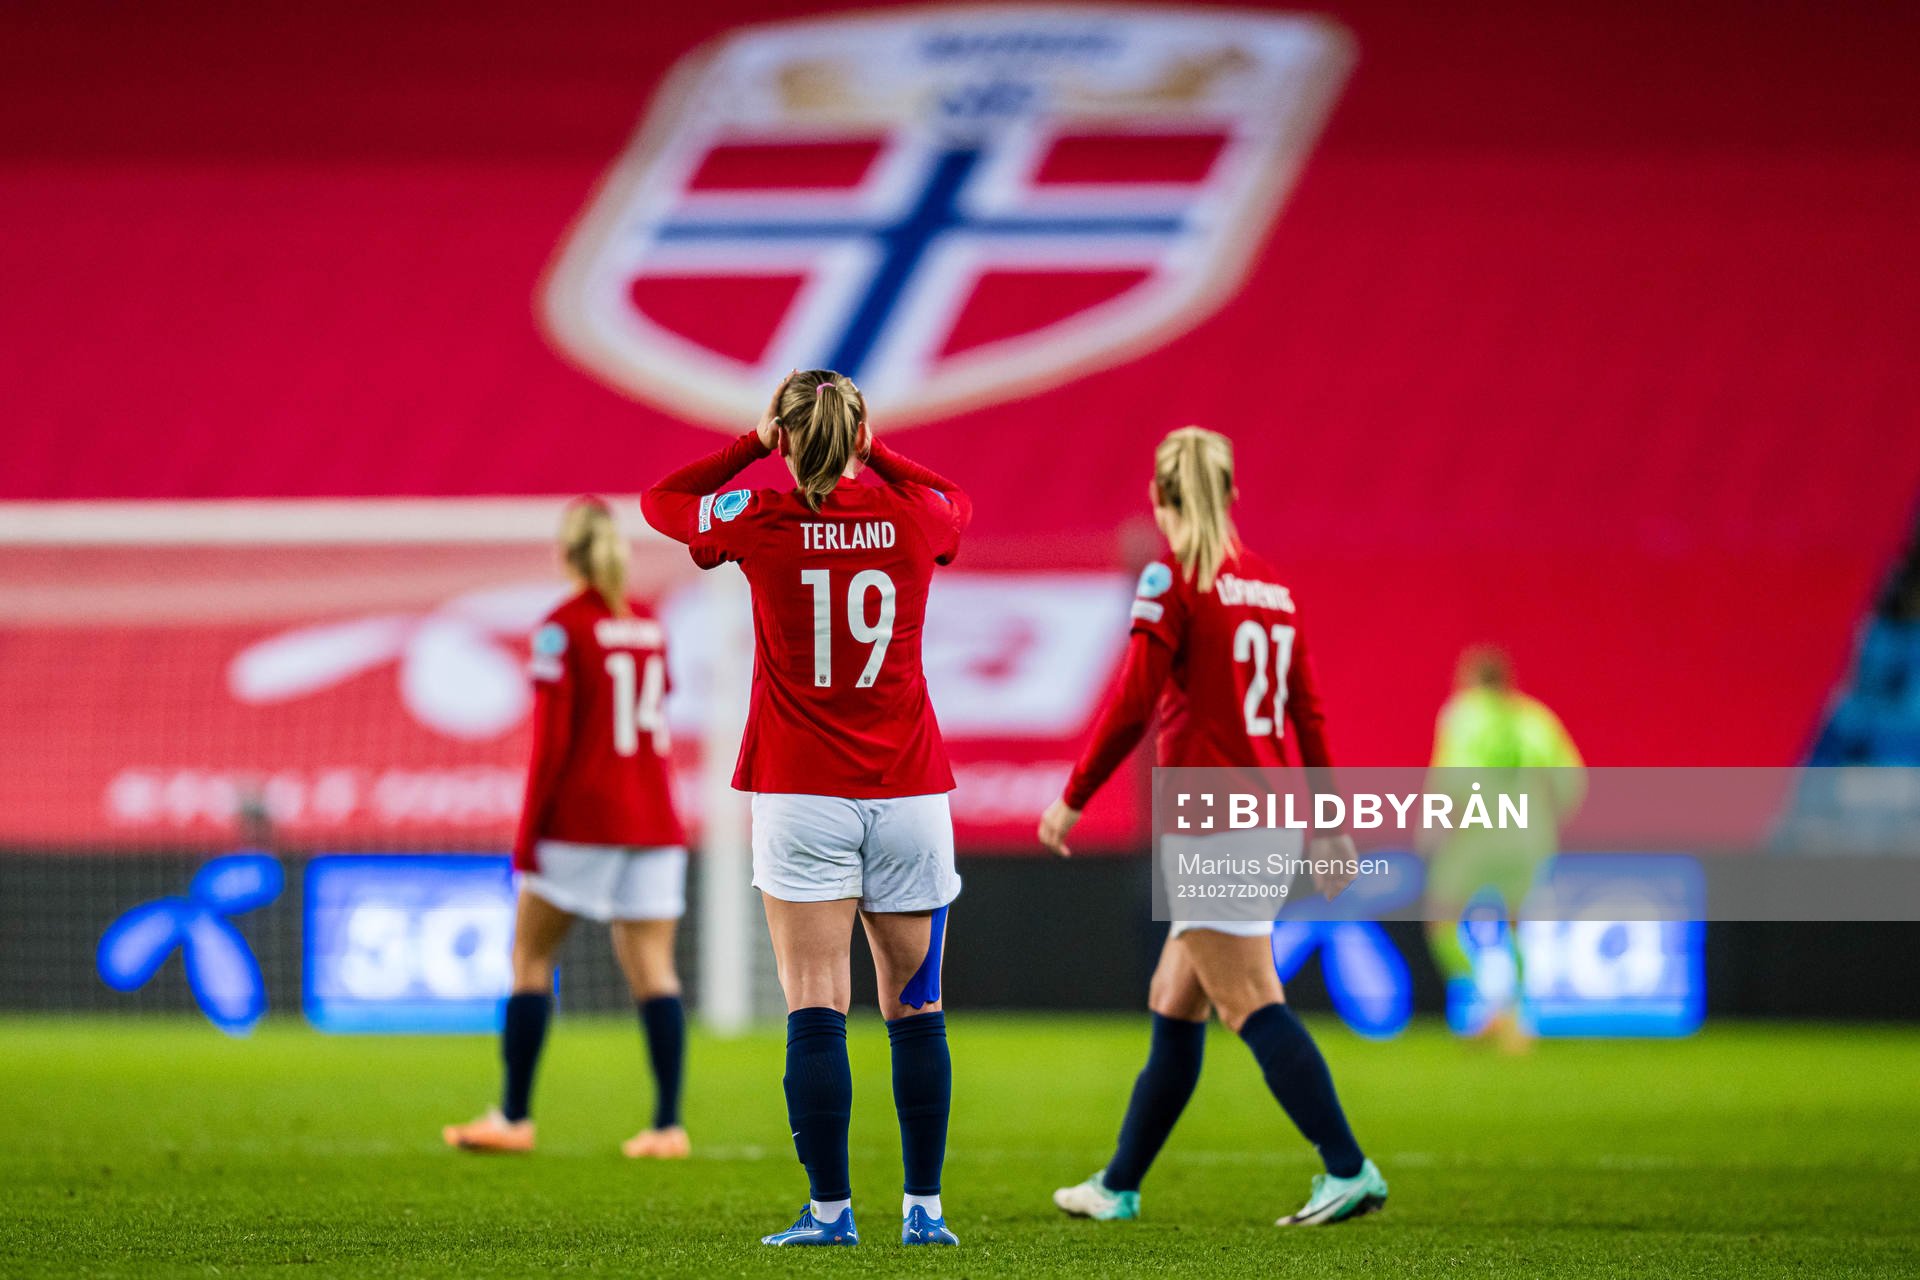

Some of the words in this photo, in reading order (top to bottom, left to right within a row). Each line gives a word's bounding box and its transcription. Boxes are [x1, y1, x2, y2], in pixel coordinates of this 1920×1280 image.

[800, 521, 896, 550] TERLAND
[801, 569, 897, 688] 19
[1233, 620, 1296, 739] 21
[604, 652, 671, 757] 14
